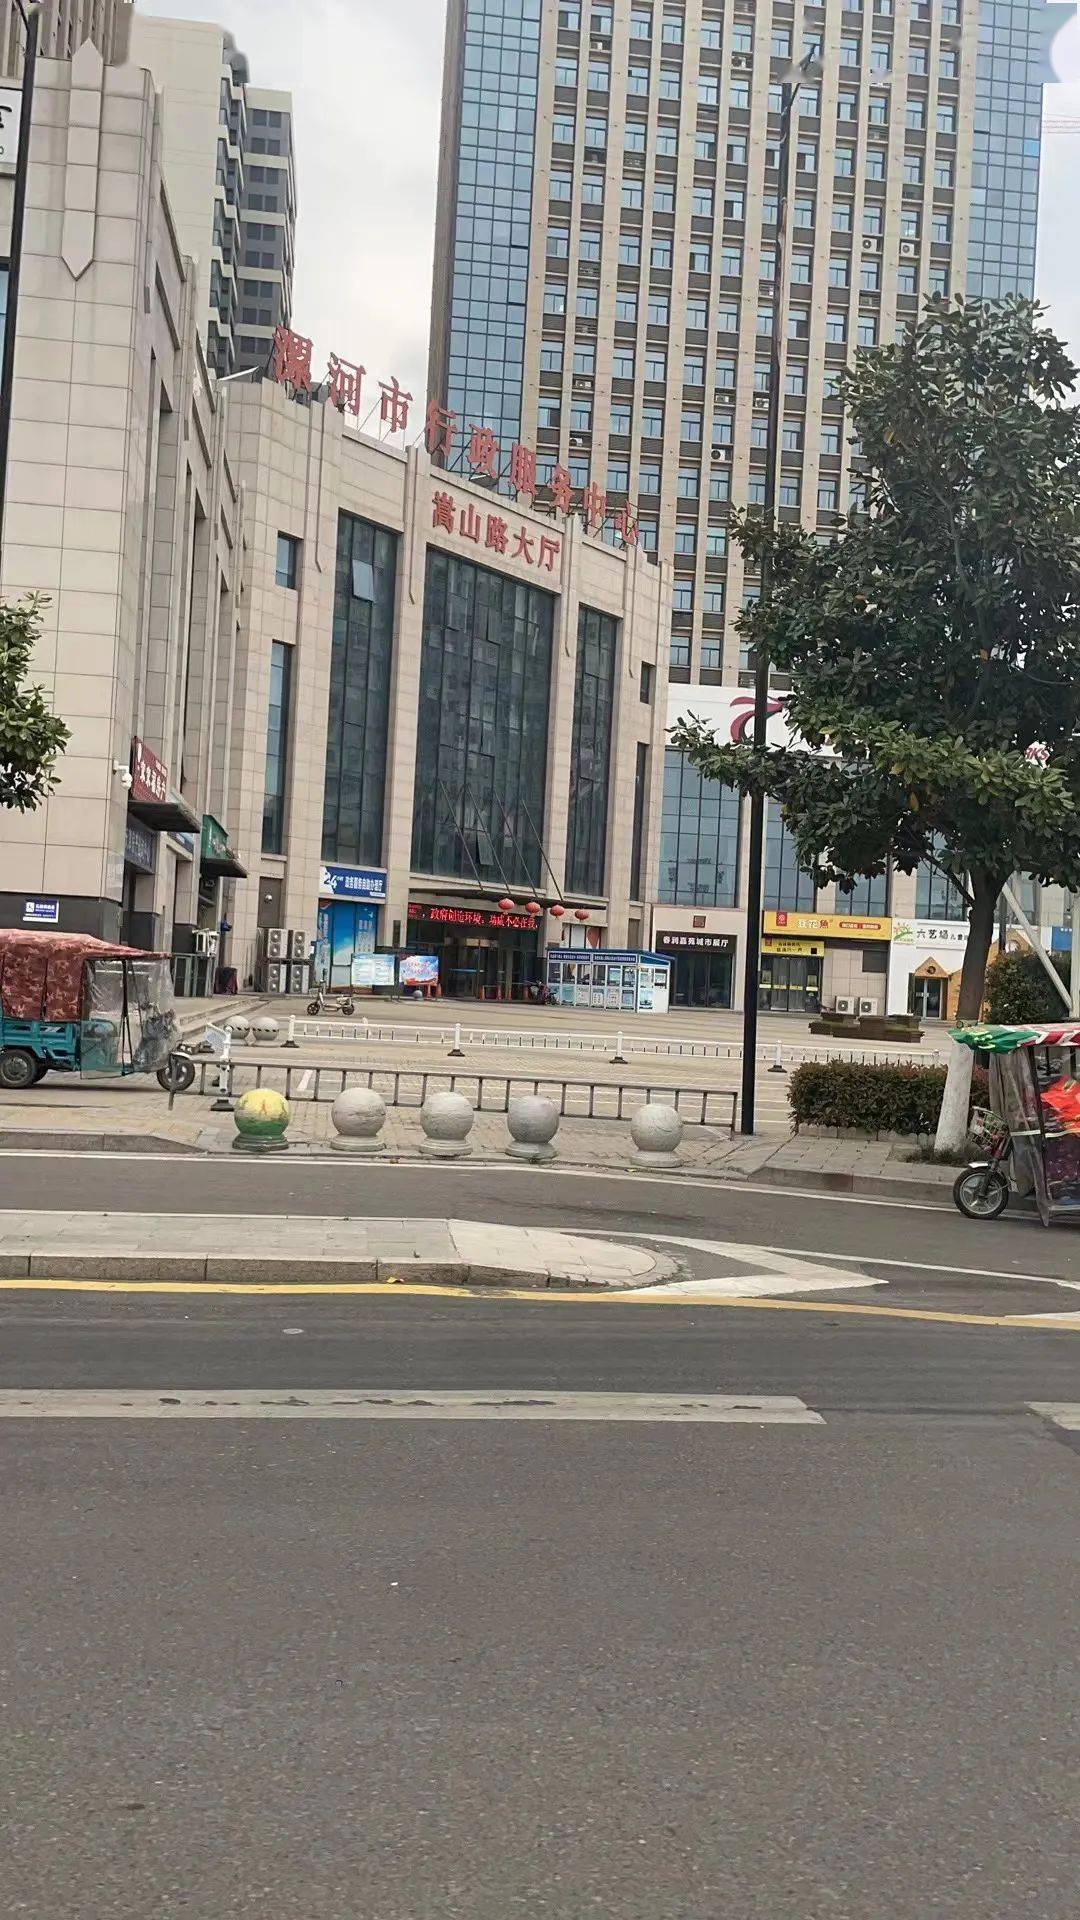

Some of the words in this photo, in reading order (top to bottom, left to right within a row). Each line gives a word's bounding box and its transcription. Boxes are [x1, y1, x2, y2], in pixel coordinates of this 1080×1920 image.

[272, 325, 639, 546] 漯河市行政服务中心
[431, 491, 562, 572] 嵩山路大厅
